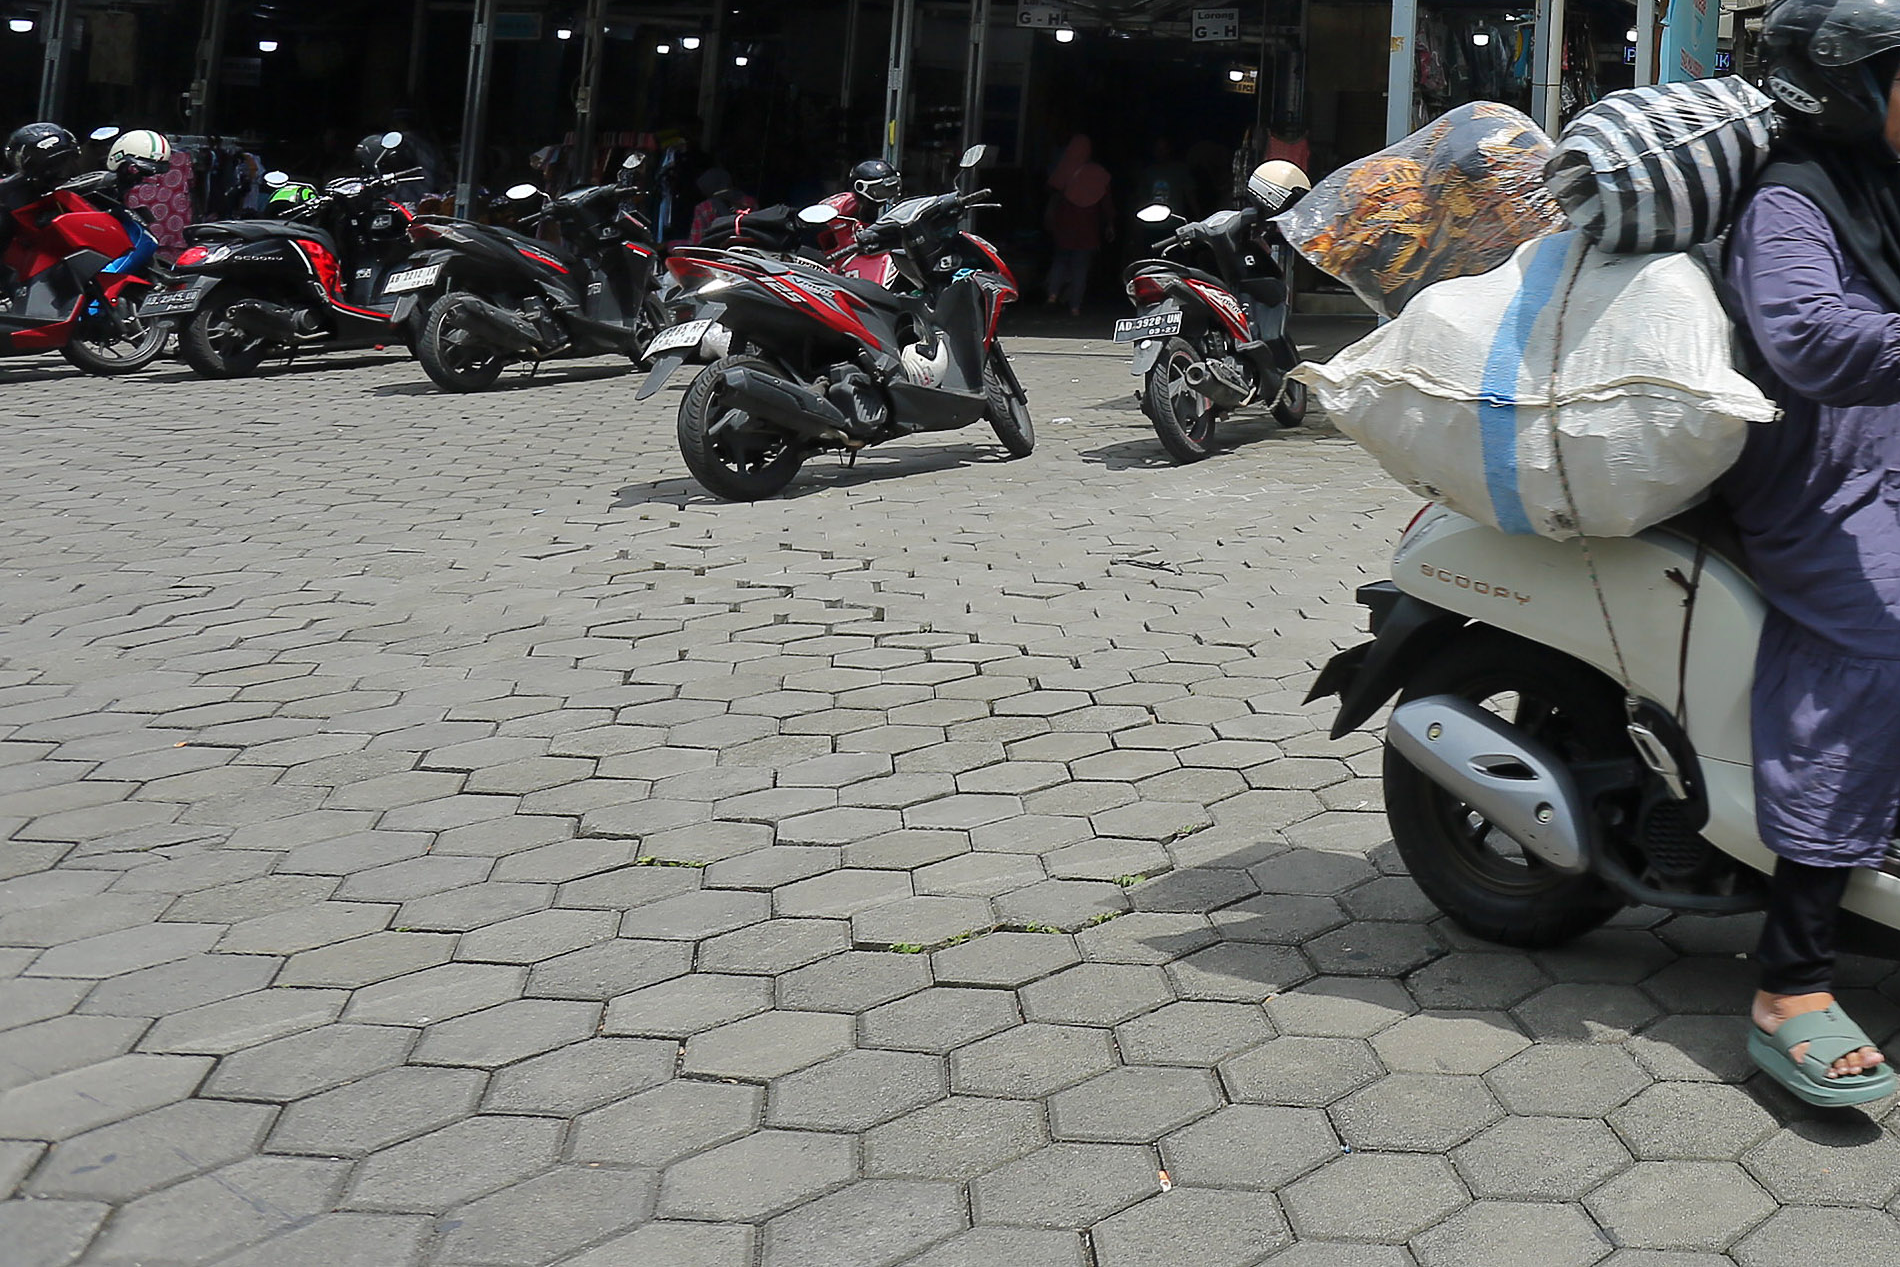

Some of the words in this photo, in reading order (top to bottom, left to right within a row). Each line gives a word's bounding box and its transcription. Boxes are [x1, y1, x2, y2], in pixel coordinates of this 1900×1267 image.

[1018, 11, 1031, 25] G
[1048, 12, 1060, 26] H
[1197, 10, 1235, 21] Lorong
[1194, 25, 1208, 39] G
[1223, 25, 1237, 38] H
[755, 276, 808, 303] 125
[1117, 321, 1133, 332] AD
[1135, 316, 1161, 329] 3928
[1420, 562, 1531, 606] SCOOPY
